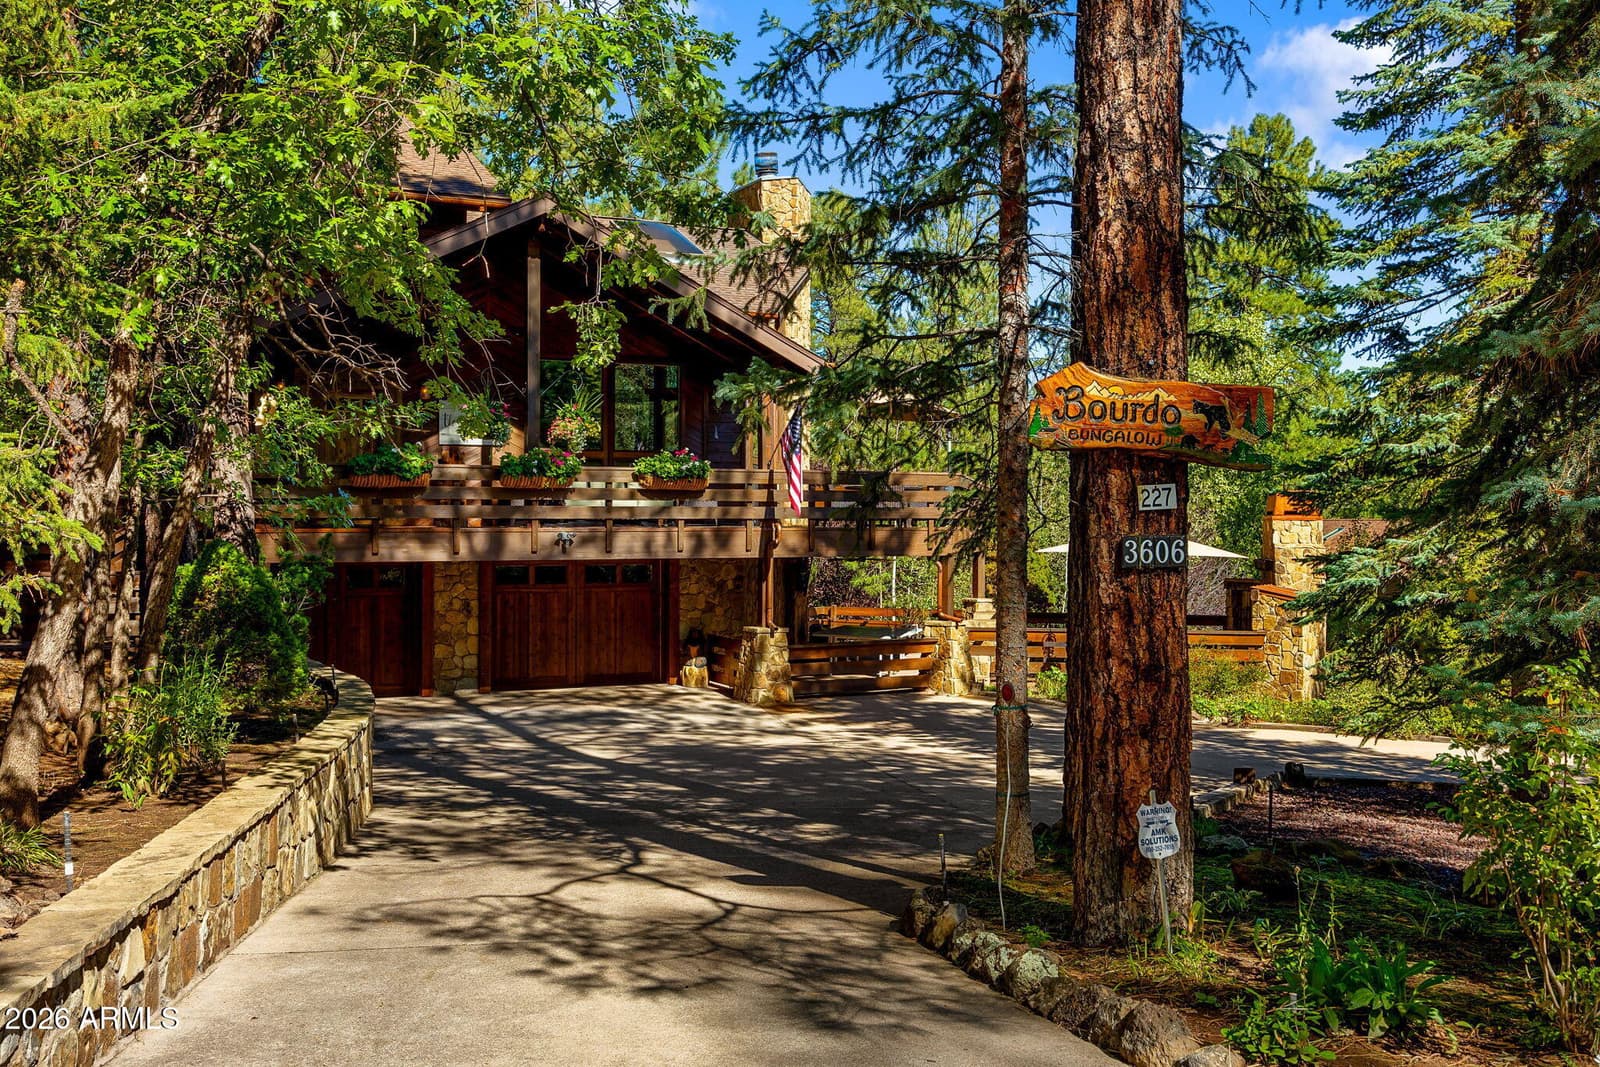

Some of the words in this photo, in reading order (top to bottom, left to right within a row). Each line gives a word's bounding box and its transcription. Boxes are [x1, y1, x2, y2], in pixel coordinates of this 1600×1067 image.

[1052, 385, 1182, 426] Bourdo
[1068, 429, 1162, 447] BUNGALOW
[1142, 487, 1171, 508] 227
[1124, 539, 1185, 564] 3606
[1140, 835, 1179, 846] SOLUTIONS
